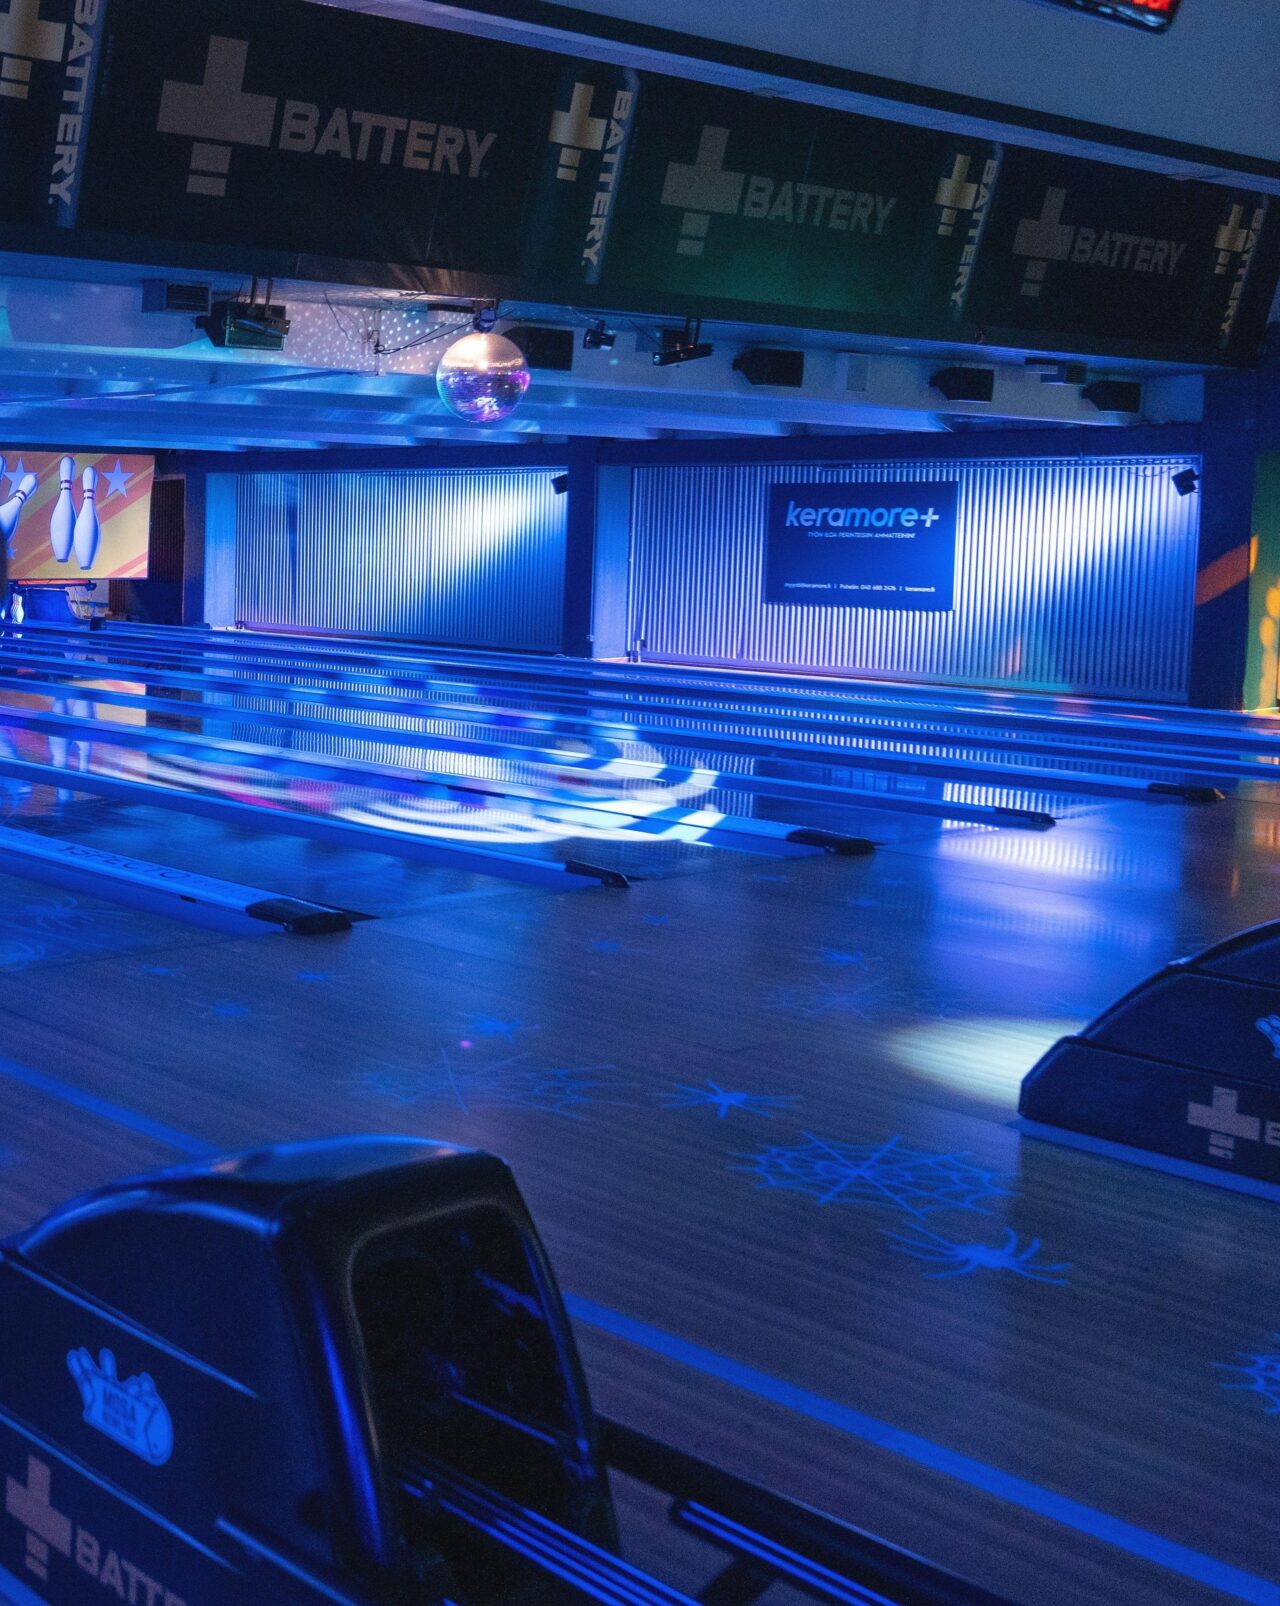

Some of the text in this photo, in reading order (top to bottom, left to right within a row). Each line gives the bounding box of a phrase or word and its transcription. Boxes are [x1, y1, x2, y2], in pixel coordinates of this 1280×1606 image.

[49, 0, 99, 205] BATTERY
[278, 99, 497, 178] BATTERY
[583, 91, 633, 265] BATTERY
[743, 175, 897, 235] BATTERY
[951, 160, 998, 306] BATTERY
[1072, 227, 1188, 275] BATTERY
